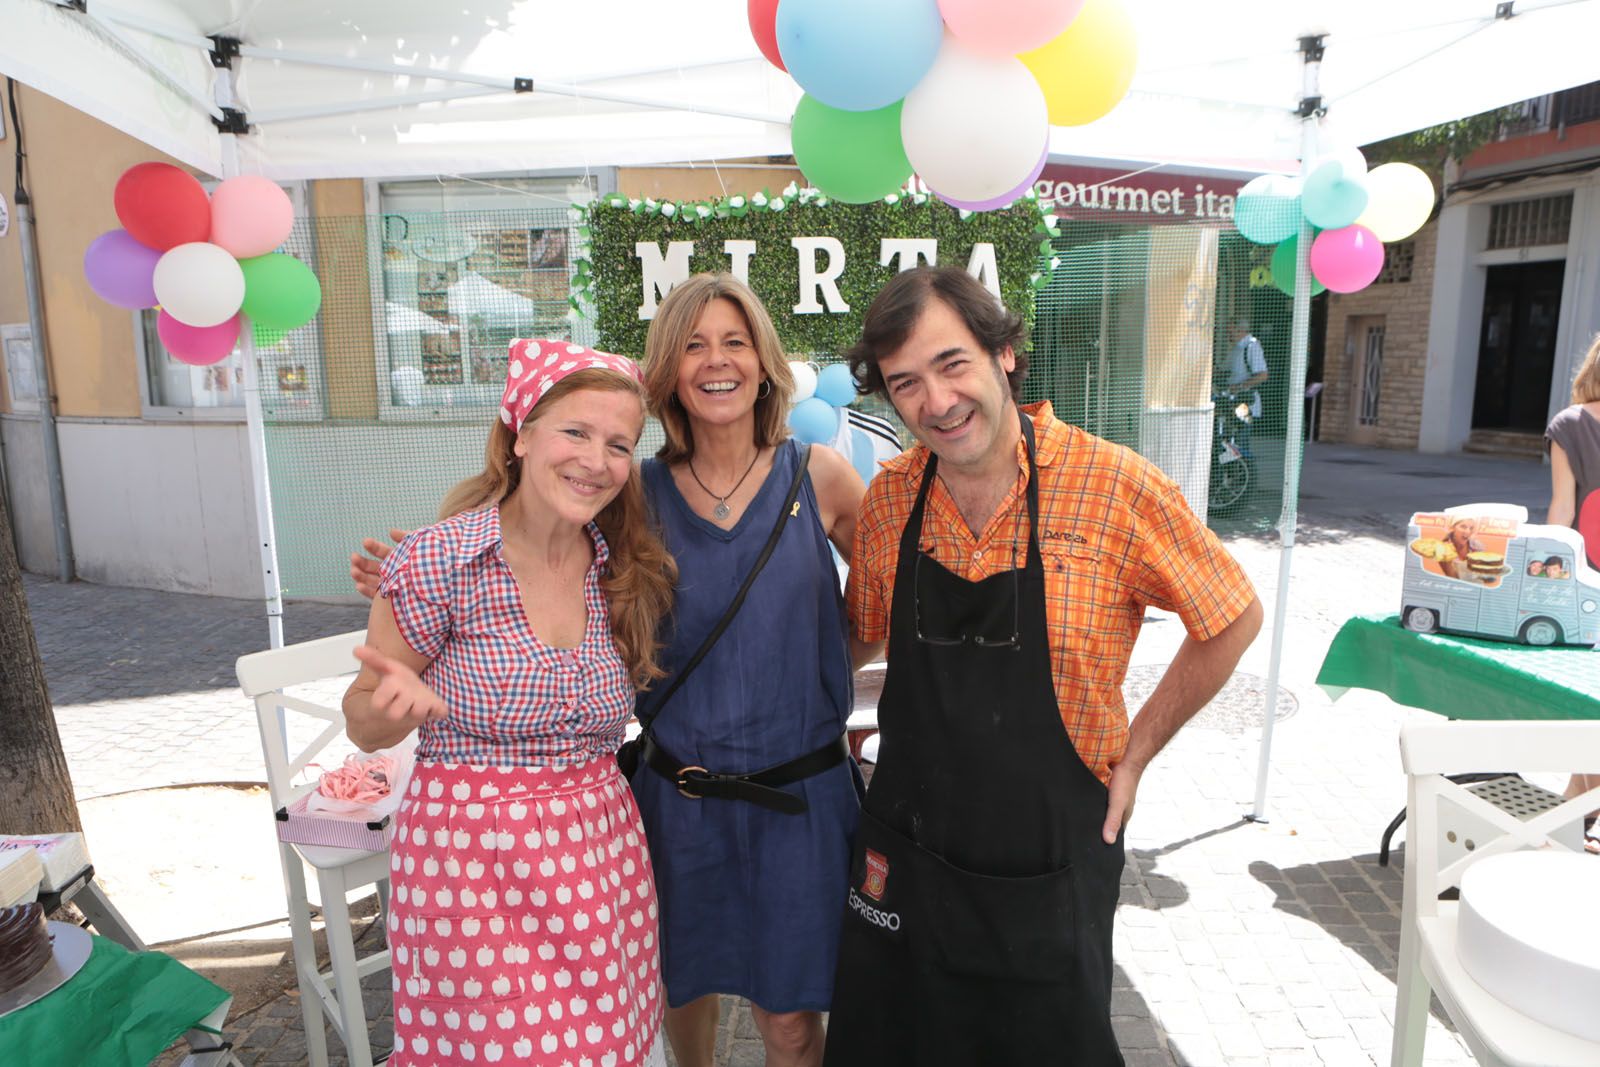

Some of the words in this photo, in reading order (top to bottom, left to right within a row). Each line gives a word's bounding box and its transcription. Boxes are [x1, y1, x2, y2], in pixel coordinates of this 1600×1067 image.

[1034, 179, 1185, 215] gourmet
[1194, 184, 1243, 219] ita
[848, 887, 900, 931] ESPRESSO
